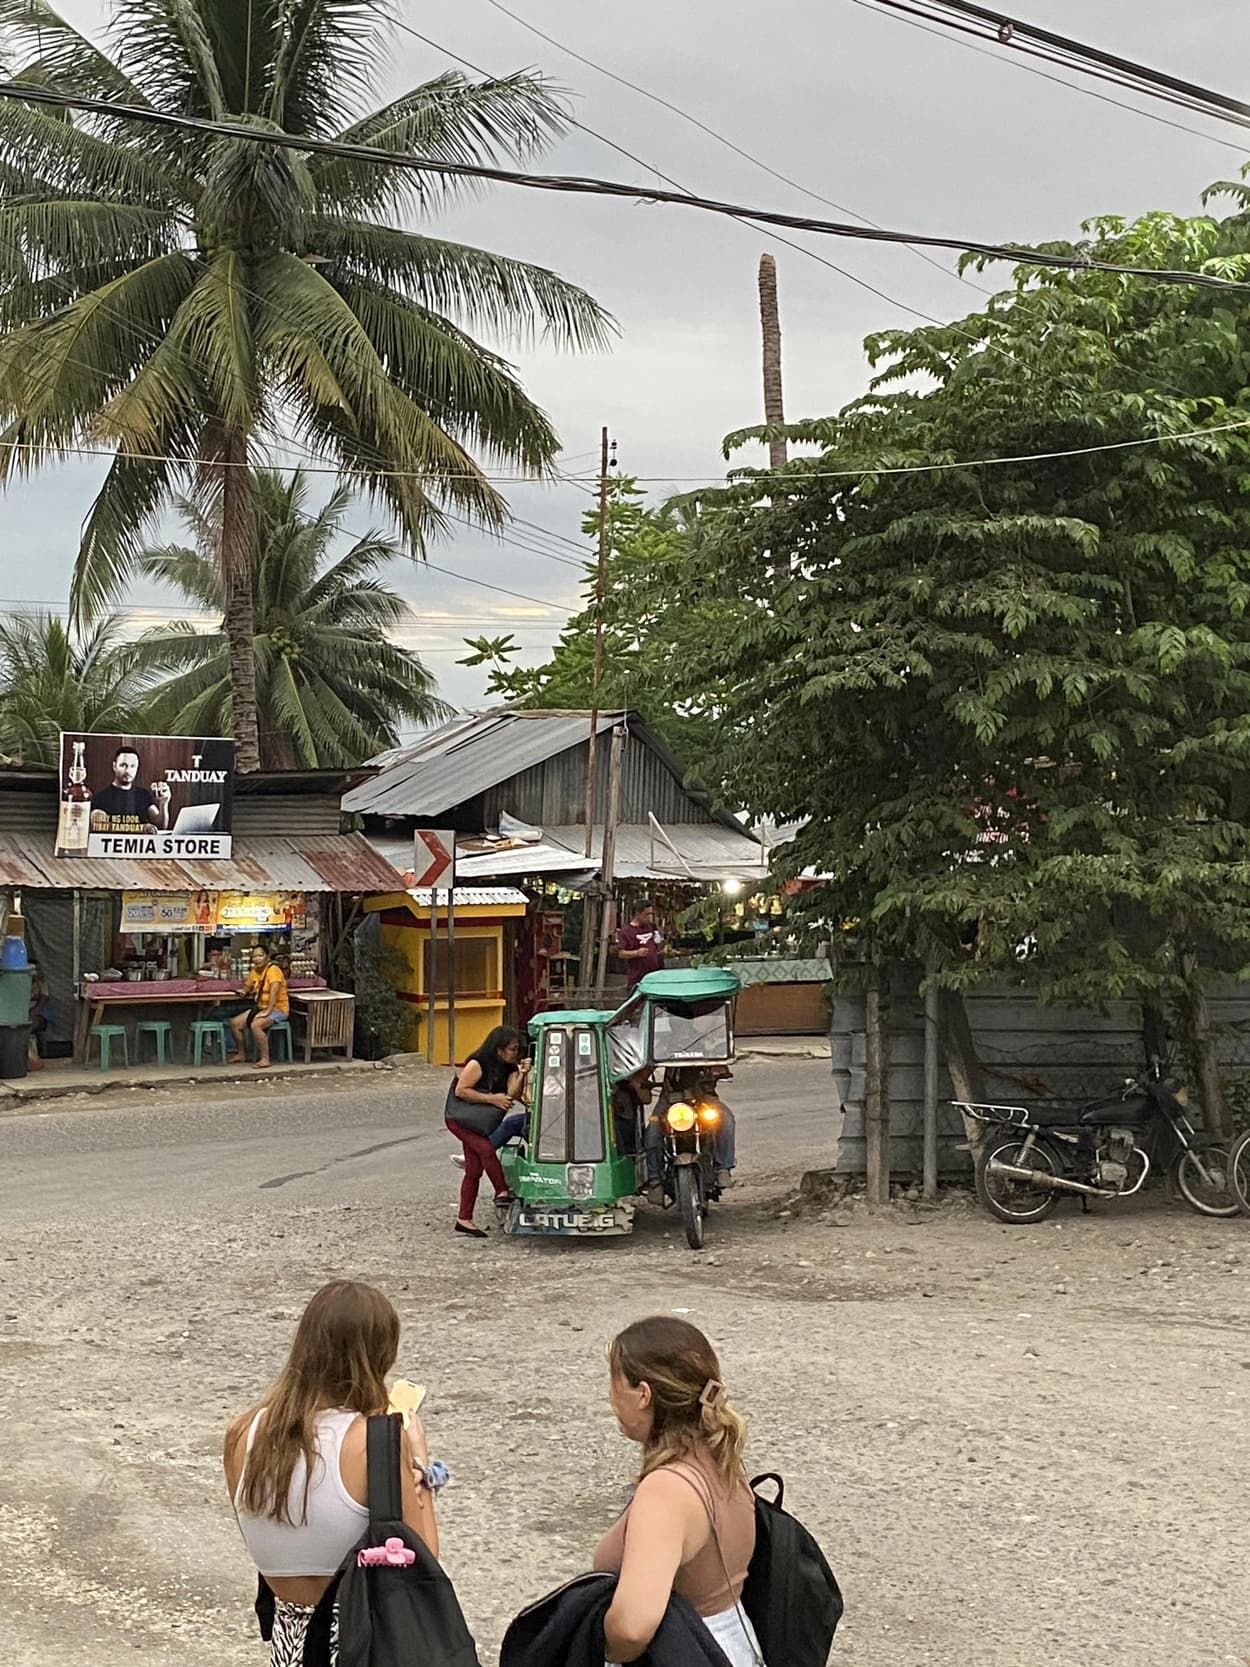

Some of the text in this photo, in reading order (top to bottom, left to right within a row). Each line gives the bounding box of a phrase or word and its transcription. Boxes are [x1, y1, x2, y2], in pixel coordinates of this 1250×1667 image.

[165, 770, 228, 783] TANDUAY
[101, 838, 221, 854] TEMIA STORE
